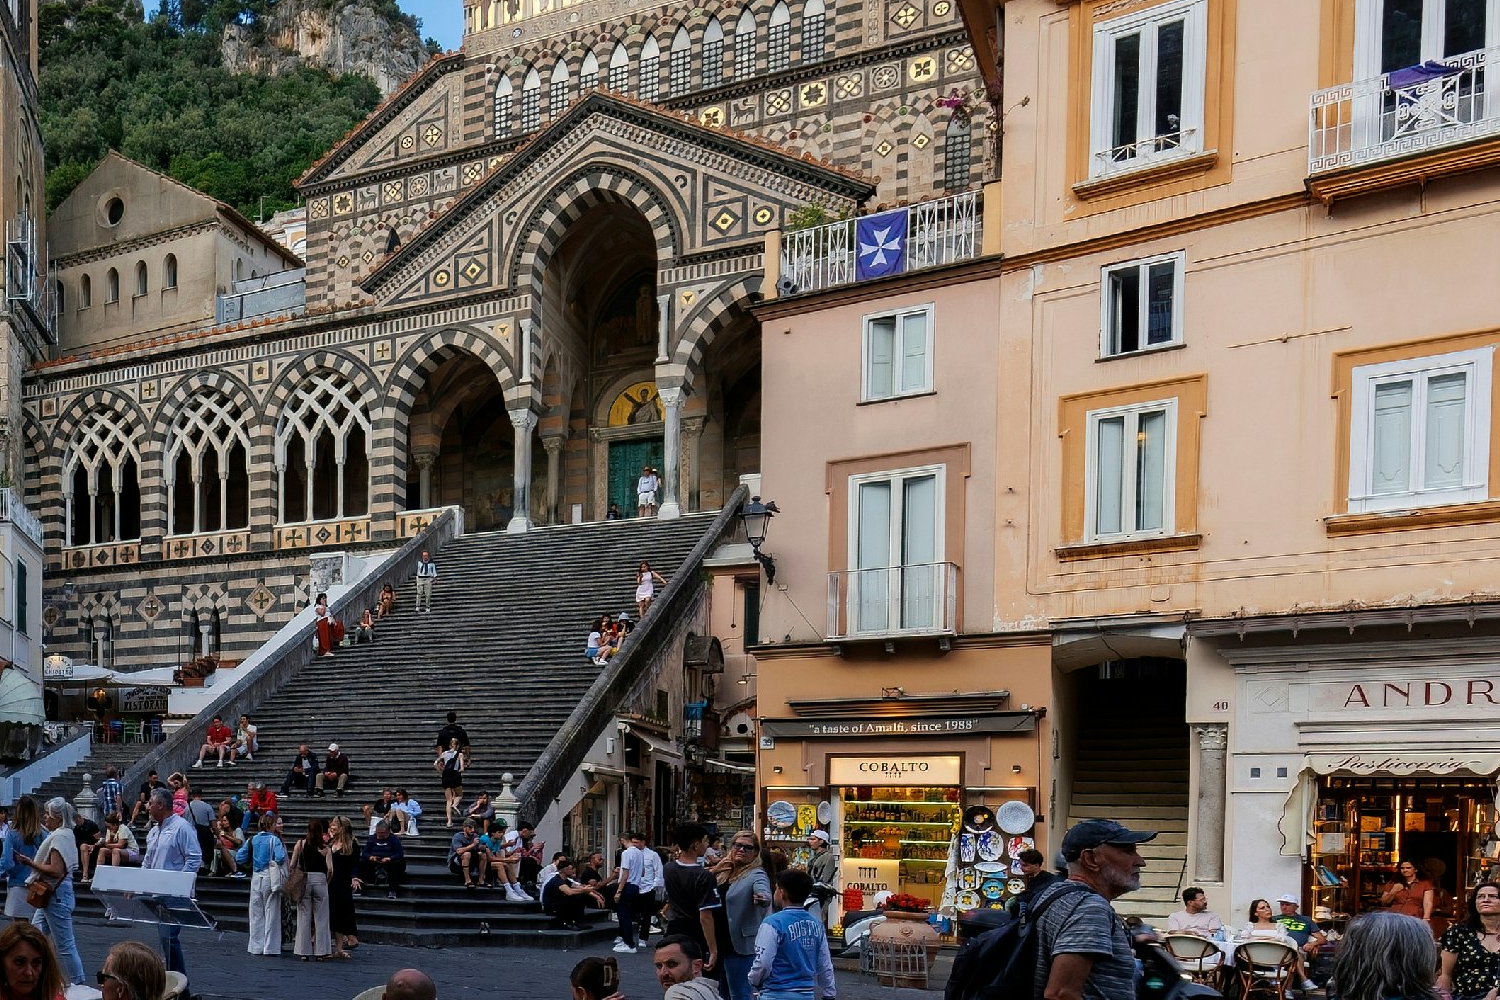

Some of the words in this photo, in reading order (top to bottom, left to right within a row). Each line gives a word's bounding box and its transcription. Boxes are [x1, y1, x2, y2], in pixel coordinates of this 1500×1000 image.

[1343, 680, 1500, 708] ANDR
[1212, 701, 1229, 711] 40
[822, 724, 849, 734] taste
[851, 723, 864, 733] of
[865, 722, 908, 733] Amalfi,
[911, 722, 942, 732] since
[944, 719, 979, 731] 1988"
[762, 738, 773, 747] 39
[859, 762, 929, 772] COBALTO
[1327, 754, 1482, 770] Pasticceria
[847, 883, 888, 891] COBALTO
